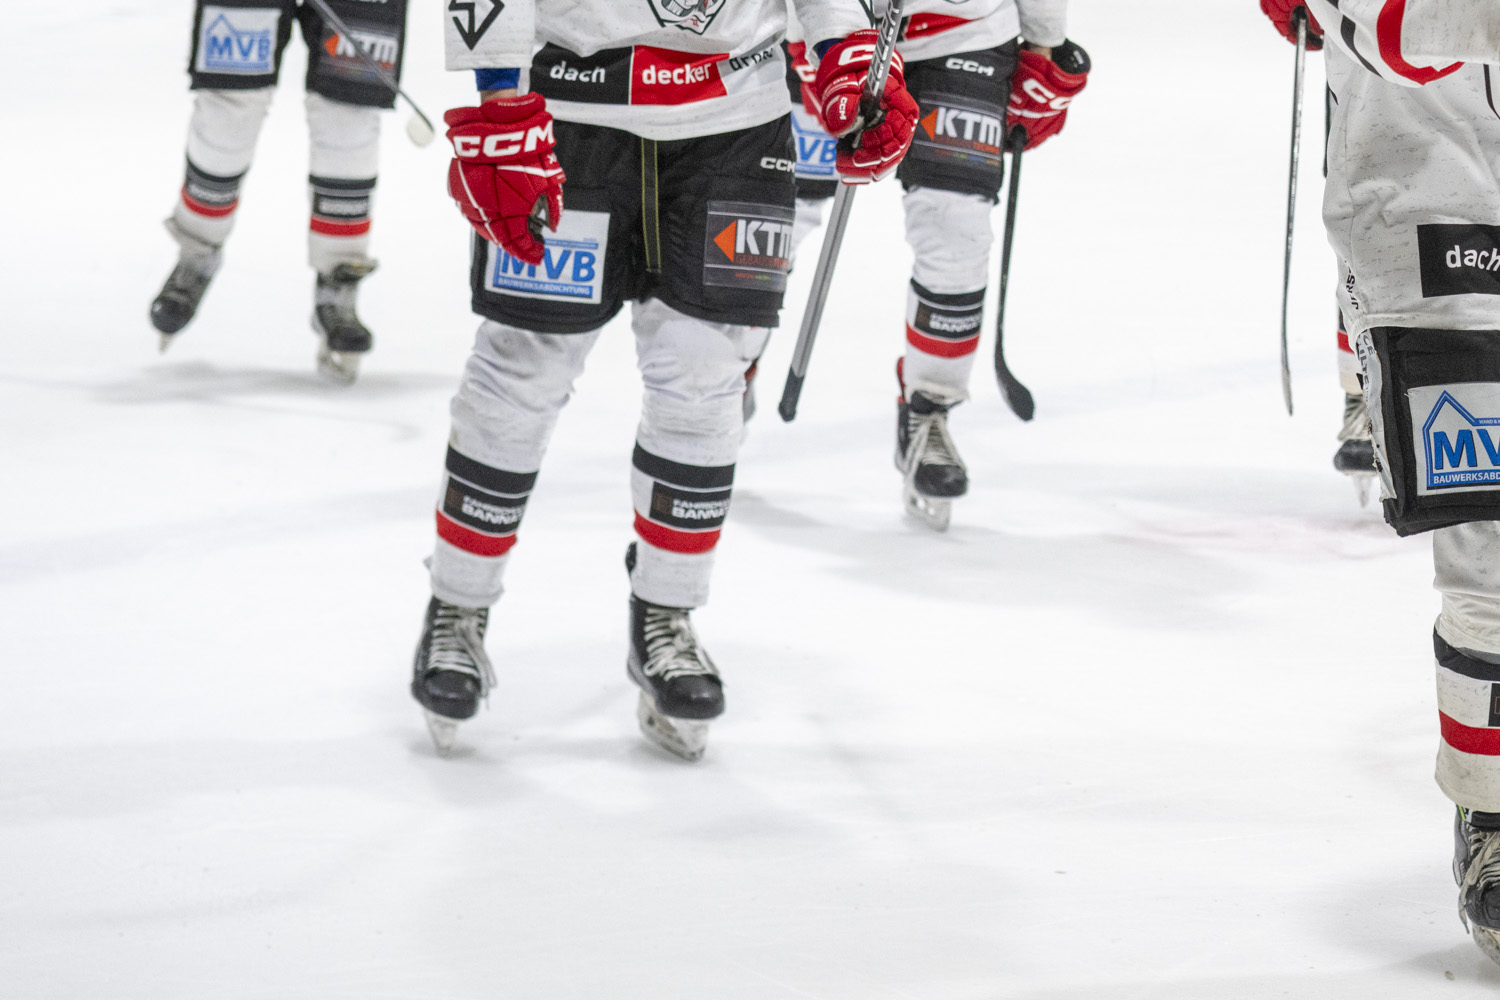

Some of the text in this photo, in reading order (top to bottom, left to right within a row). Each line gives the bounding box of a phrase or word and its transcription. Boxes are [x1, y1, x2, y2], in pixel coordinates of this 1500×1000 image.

[210, 33, 271, 60] MVB
[550, 61, 606, 85] dach
[642, 61, 713, 86] decker
[945, 57, 995, 77] CCM
[838, 96, 848, 121] CCM
[453, 119, 555, 158] CCM
[934, 106, 1002, 148] KTM
[797, 137, 837, 163] VB
[760, 156, 796, 174] CCM
[501, 247, 597, 283] MVB
